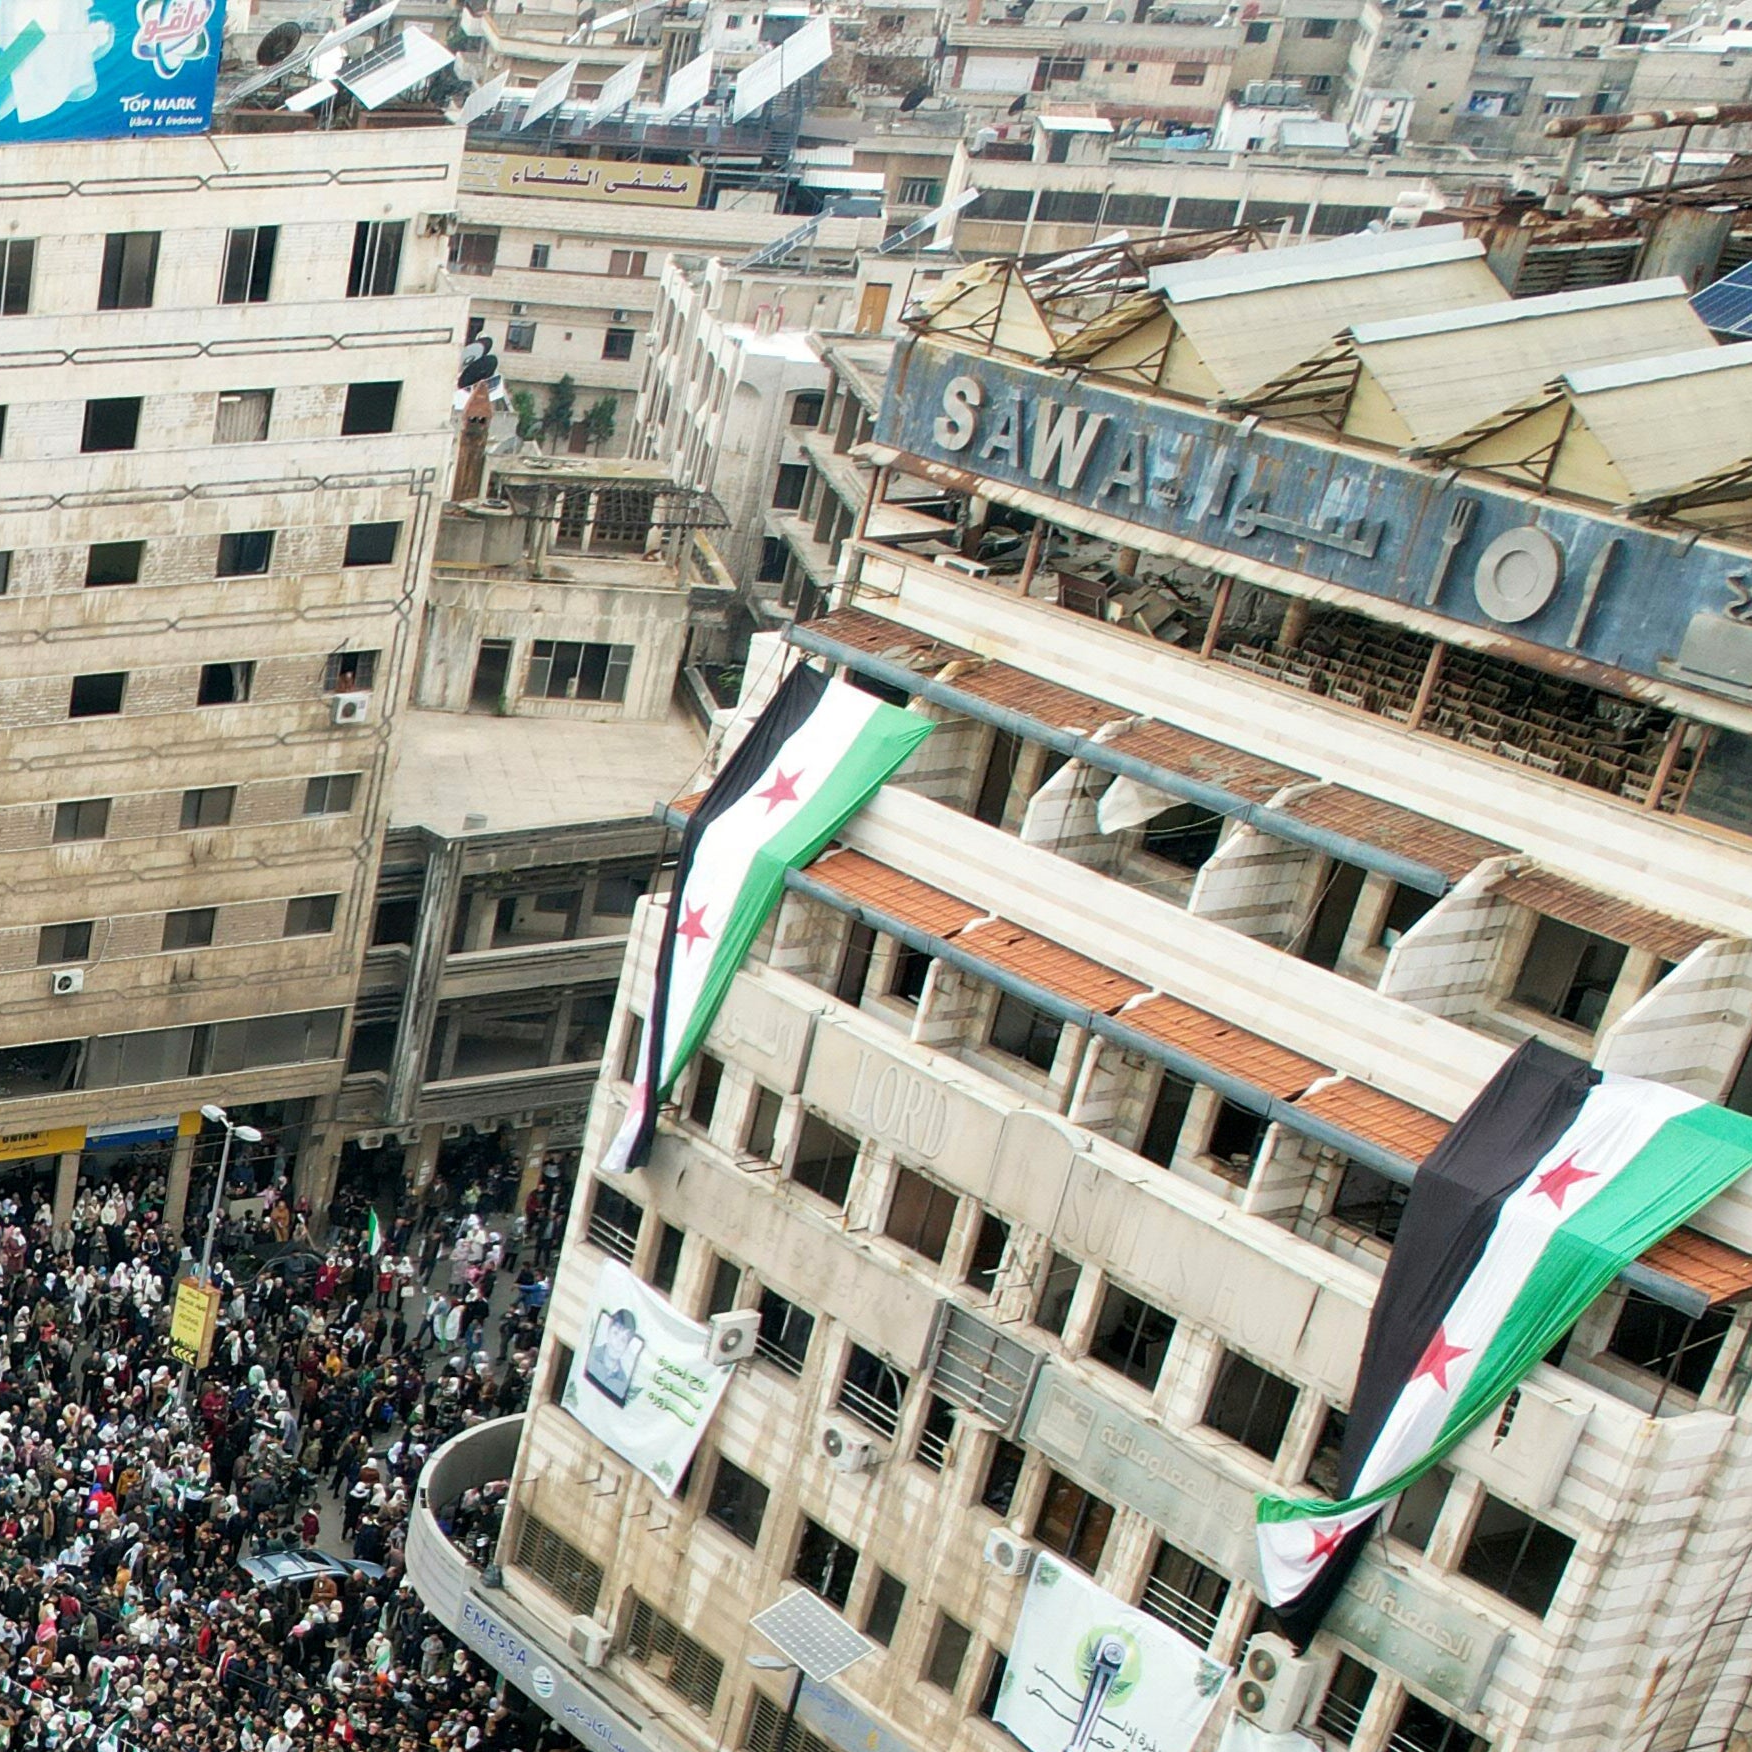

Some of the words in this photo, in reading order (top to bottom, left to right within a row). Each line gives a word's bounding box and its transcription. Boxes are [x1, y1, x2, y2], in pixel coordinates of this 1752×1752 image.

[119, 92, 151, 112] TOP
[153, 97, 197, 111] MARK
[511, 161, 600, 187] الشفاء
[847, 1049, 948, 1158] LORD
[2, 1133, 39, 1145] UNION
[463, 1602, 527, 1665] EMESSA
[1375, 1590, 1475, 1663] الجمعية
